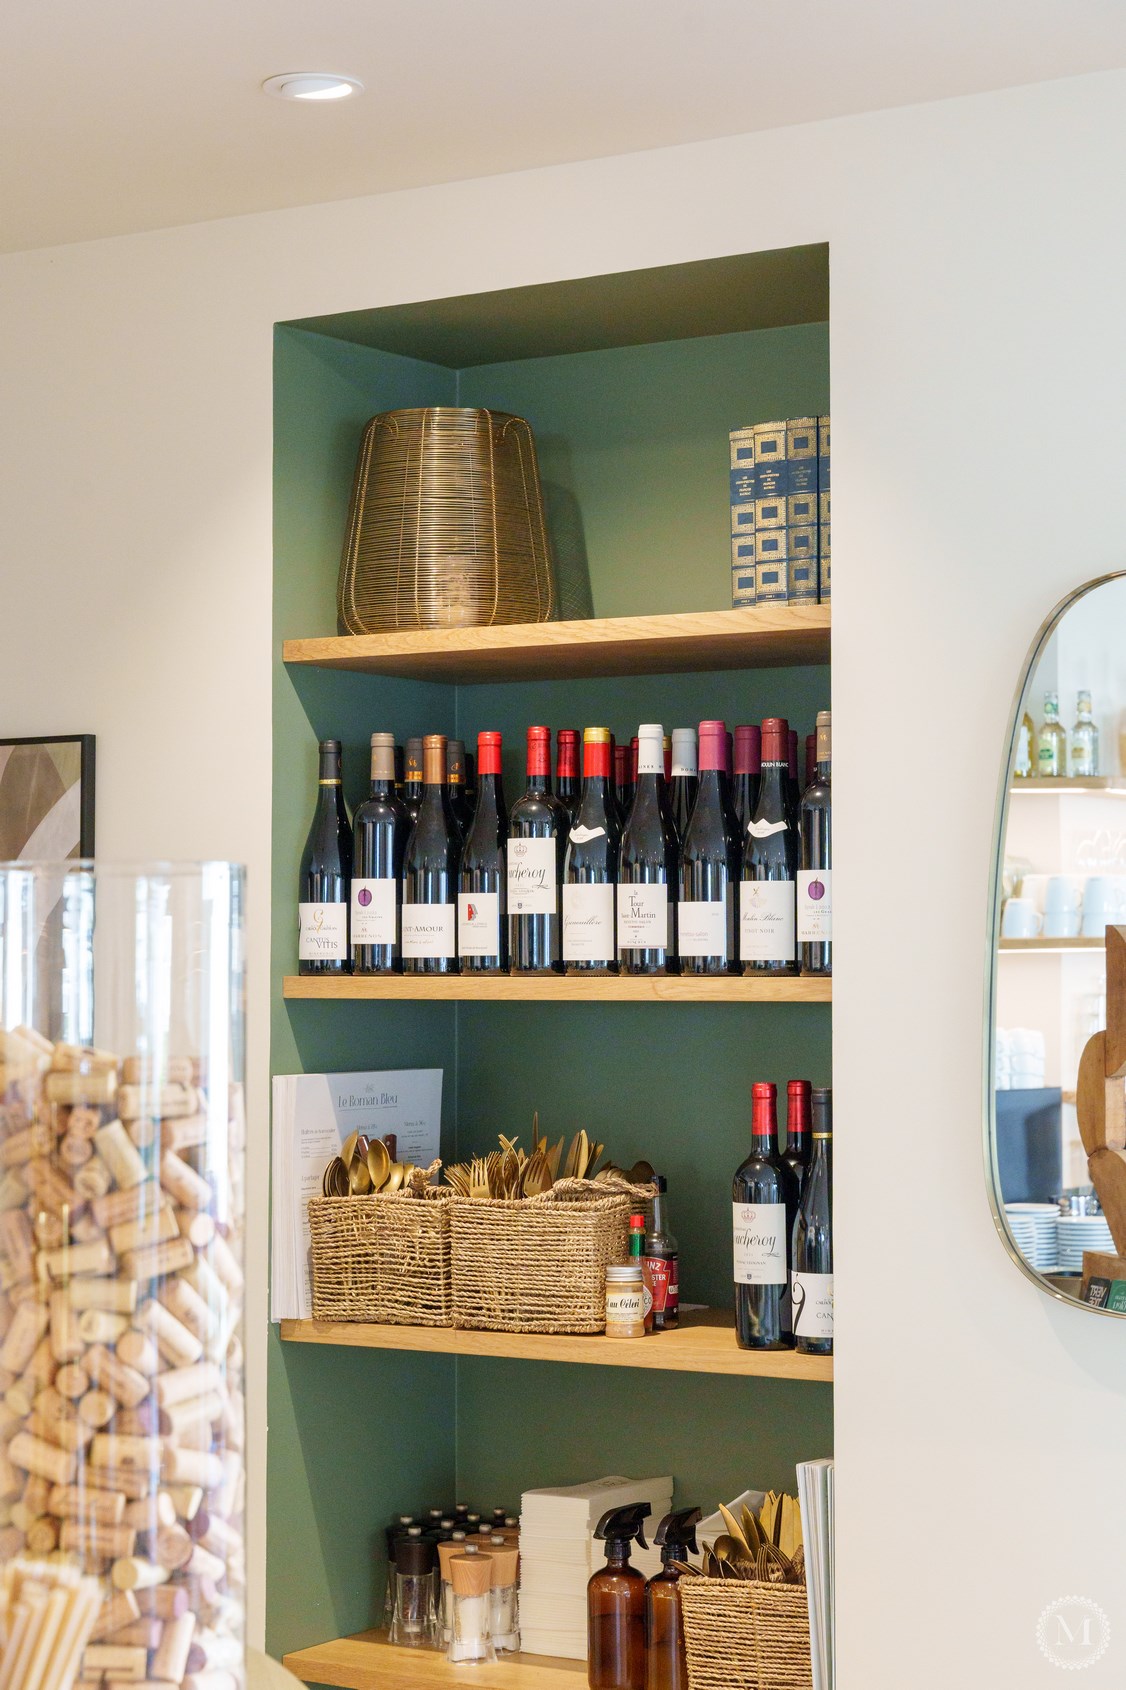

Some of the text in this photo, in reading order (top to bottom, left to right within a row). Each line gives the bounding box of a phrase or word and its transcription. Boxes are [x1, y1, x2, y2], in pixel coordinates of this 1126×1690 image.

[629, 896, 644, 907] Tour
[760, 912, 784, 921] Blanc
[315, 939, 338, 949] VITIS
[338, 1092, 398, 1108] Le Roman Bleu
[647, 1261, 661, 1271] INZ
[620, 1298, 640, 1309] Céleri
